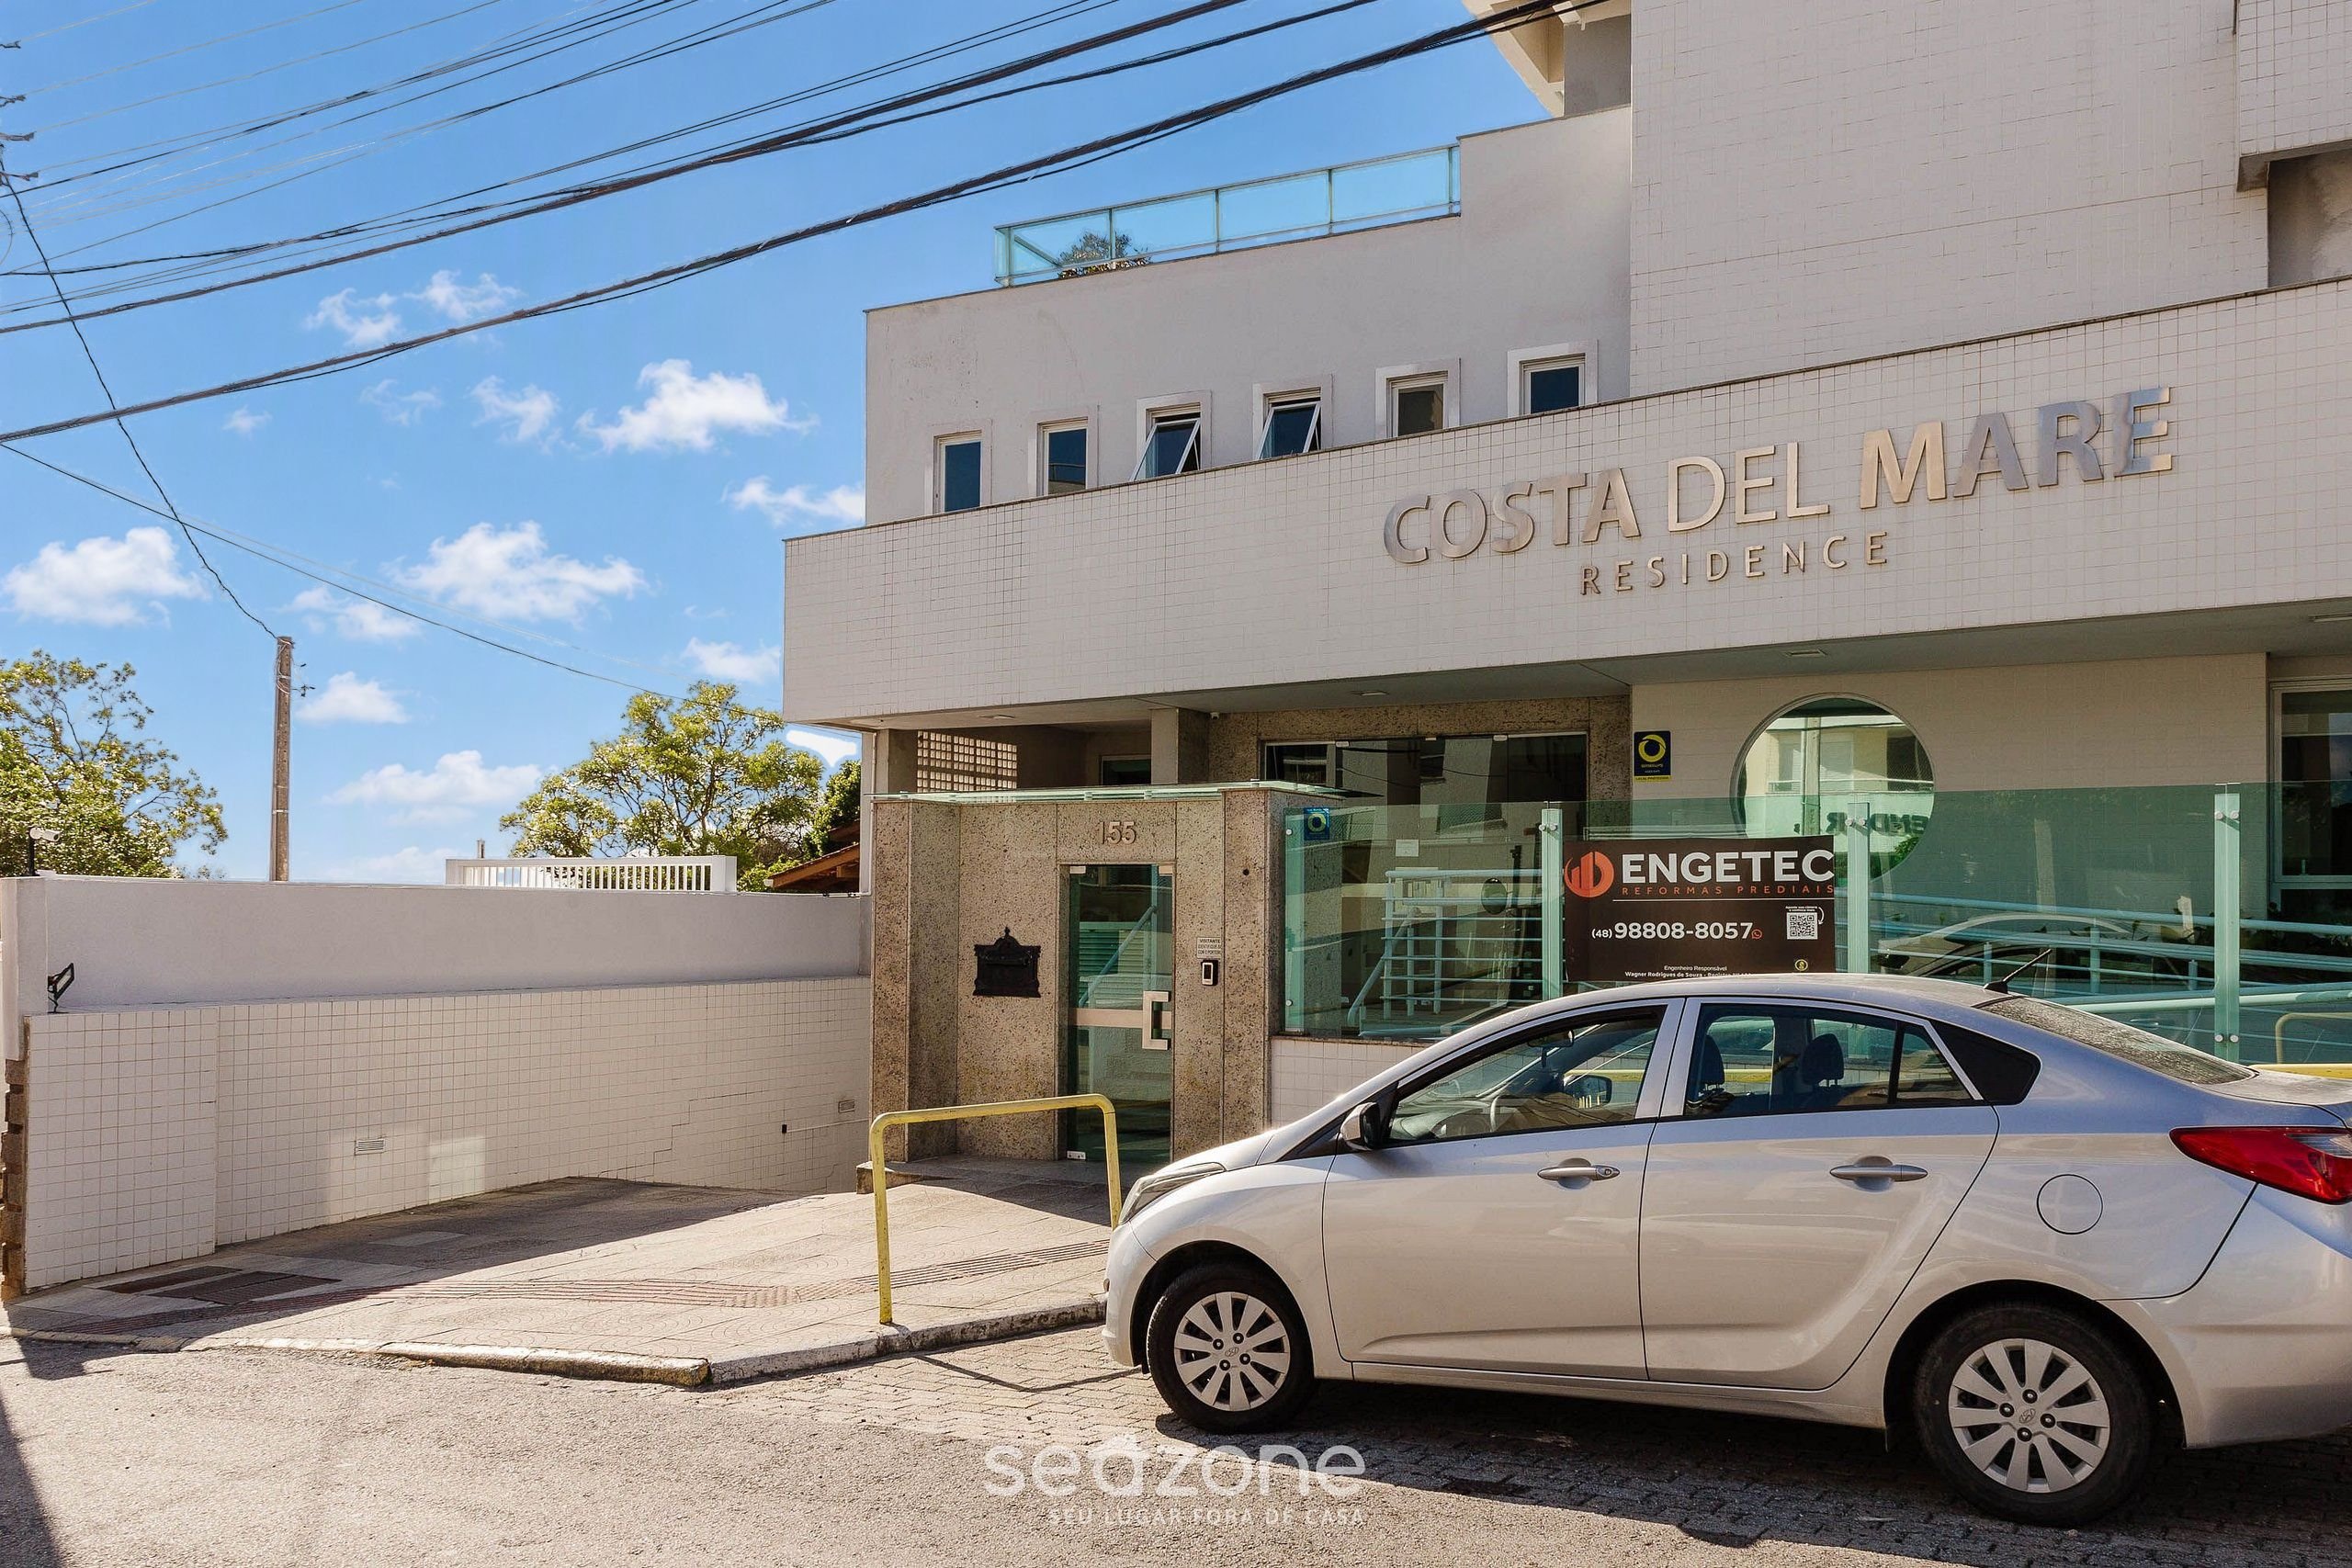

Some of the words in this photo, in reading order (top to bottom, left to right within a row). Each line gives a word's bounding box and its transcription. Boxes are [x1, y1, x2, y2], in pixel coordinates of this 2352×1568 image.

[1384, 468, 1641, 564] COSTA
[1668, 442, 1830, 532] DEL
[1860, 387, 2172, 509] MARE
[1580, 531, 1887, 595] RESIDENCE
[1097, 820, 1136, 845] 155
[1622, 850, 1835, 884] ENGETEC
[1622, 886, 1723, 896] REFORMAS
[1737, 885, 1835, 895] PREDIAIS
[1591, 929, 1612, 939] (48)
[1614, 922, 1753, 940] 98808-8057
